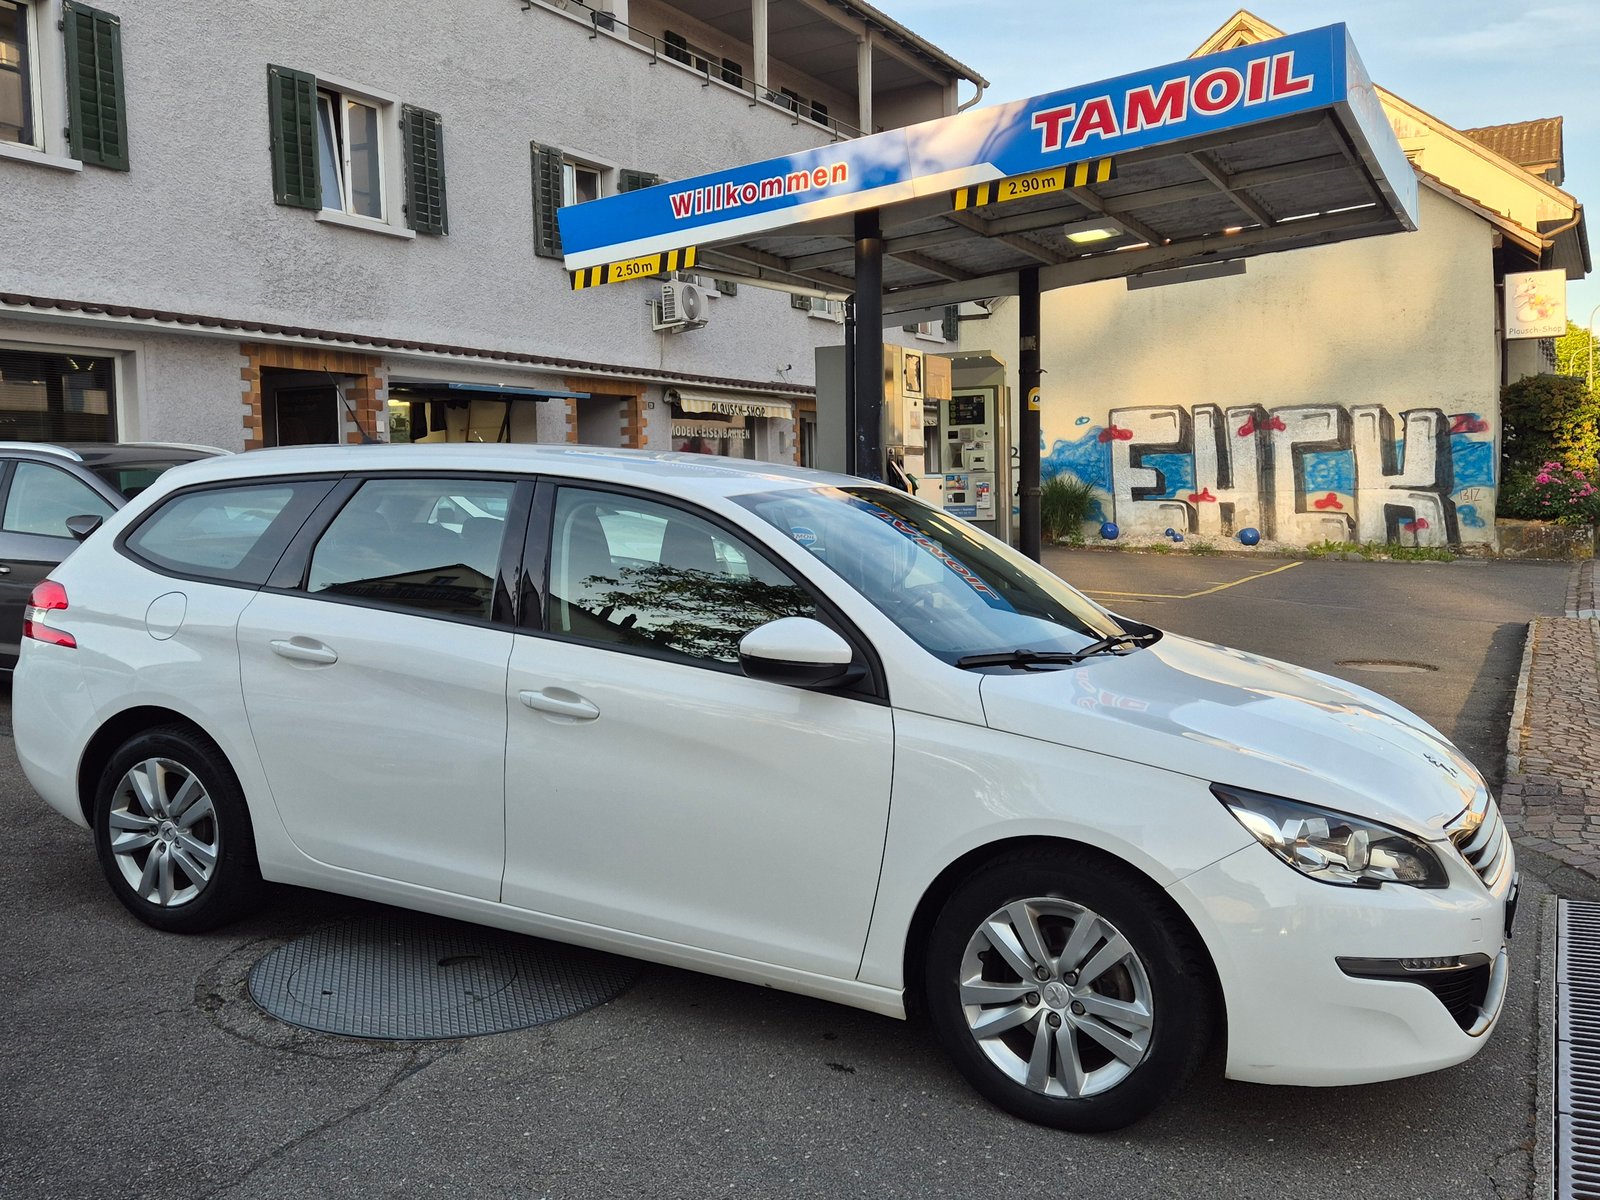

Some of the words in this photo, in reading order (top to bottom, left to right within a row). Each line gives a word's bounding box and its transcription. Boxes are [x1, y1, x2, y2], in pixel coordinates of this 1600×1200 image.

[1031, 50, 1314, 153] TAMOIL
[669, 161, 849, 219] Willkommen
[1008, 177, 1040, 195] 2.90
[615, 262, 640, 278] 2.50
